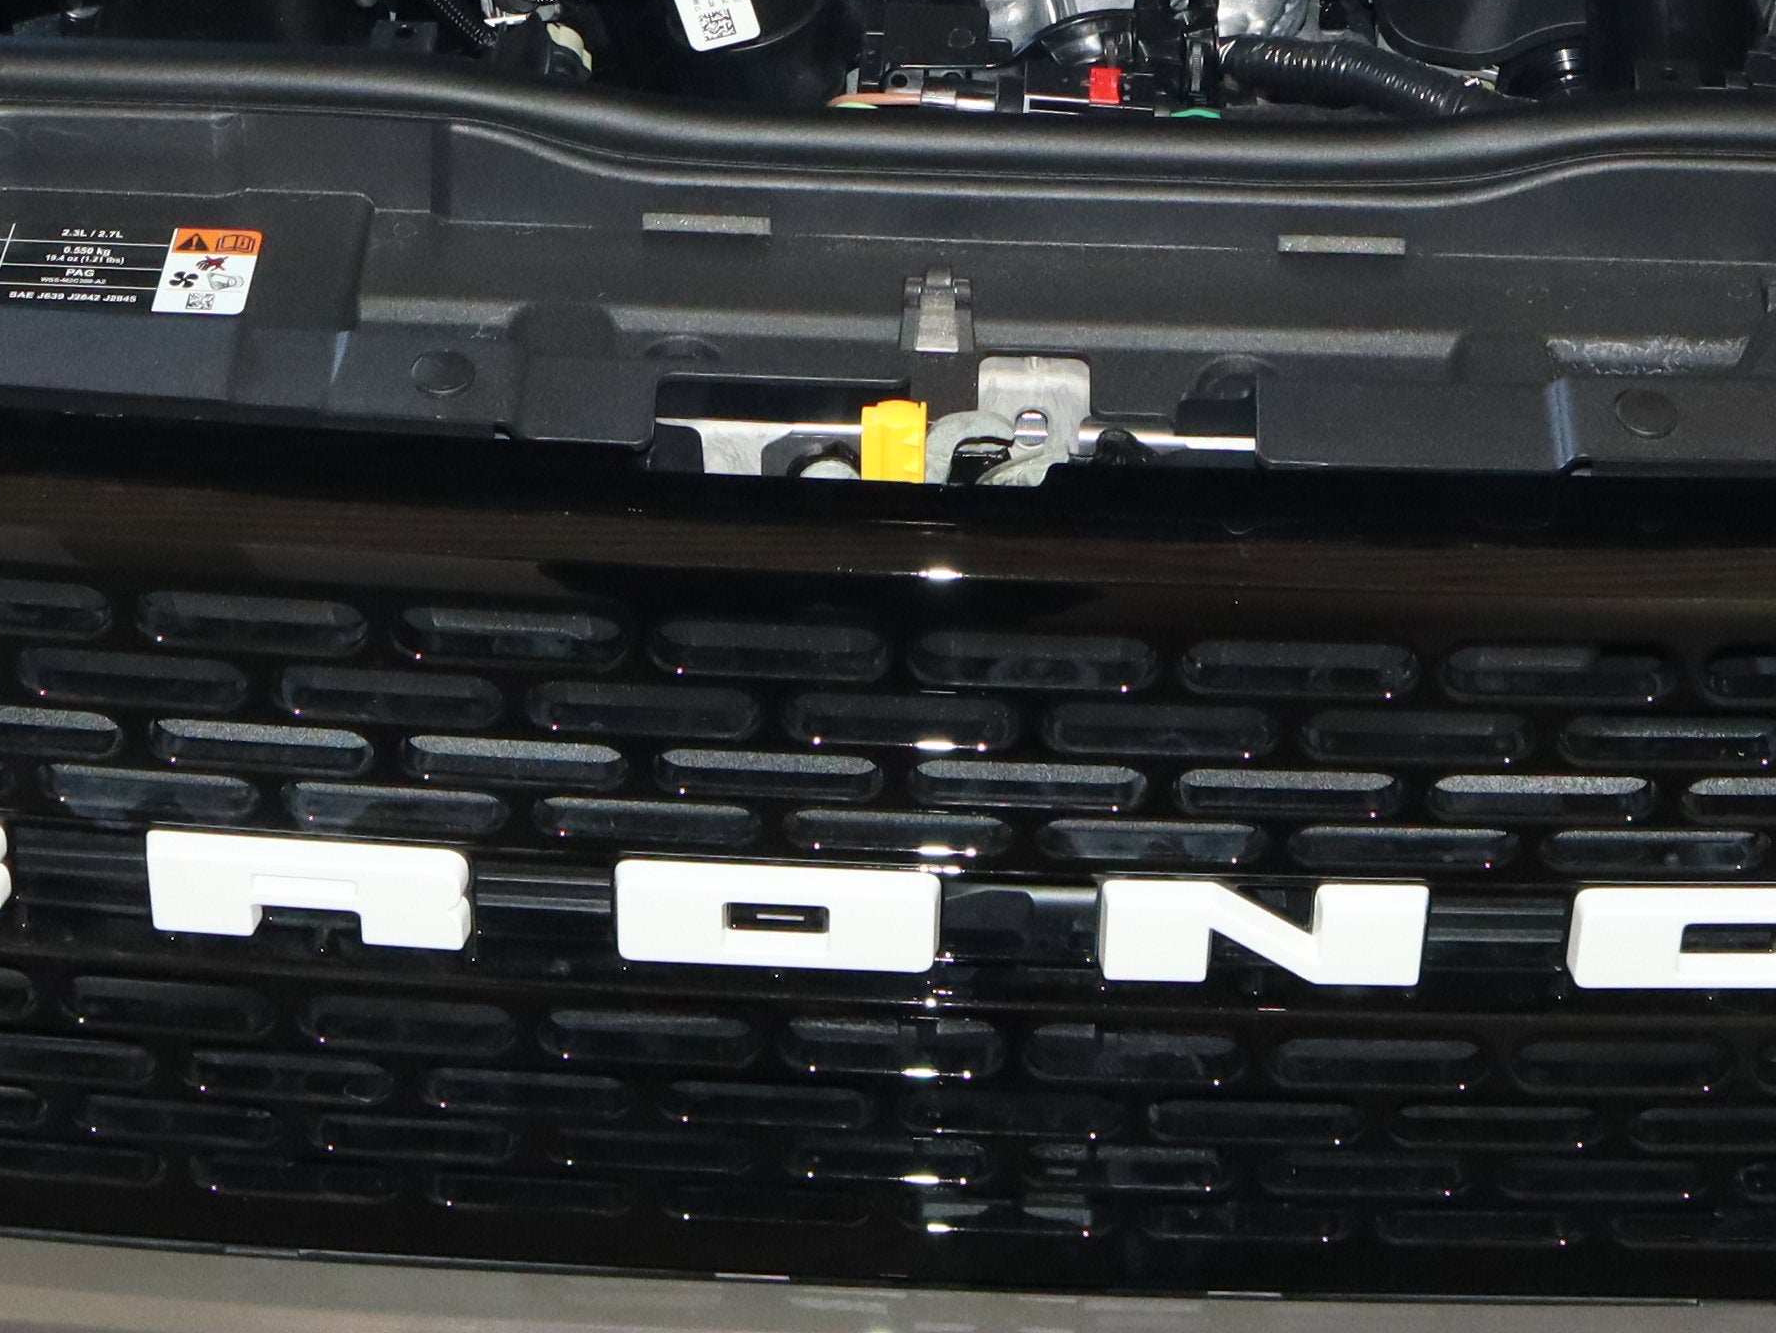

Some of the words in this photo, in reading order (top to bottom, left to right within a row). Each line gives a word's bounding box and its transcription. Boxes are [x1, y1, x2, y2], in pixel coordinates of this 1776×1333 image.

[96, 247, 111, 257] kg
[65, 269, 95, 277] PAG
[9, 291, 35, 299] SAE
